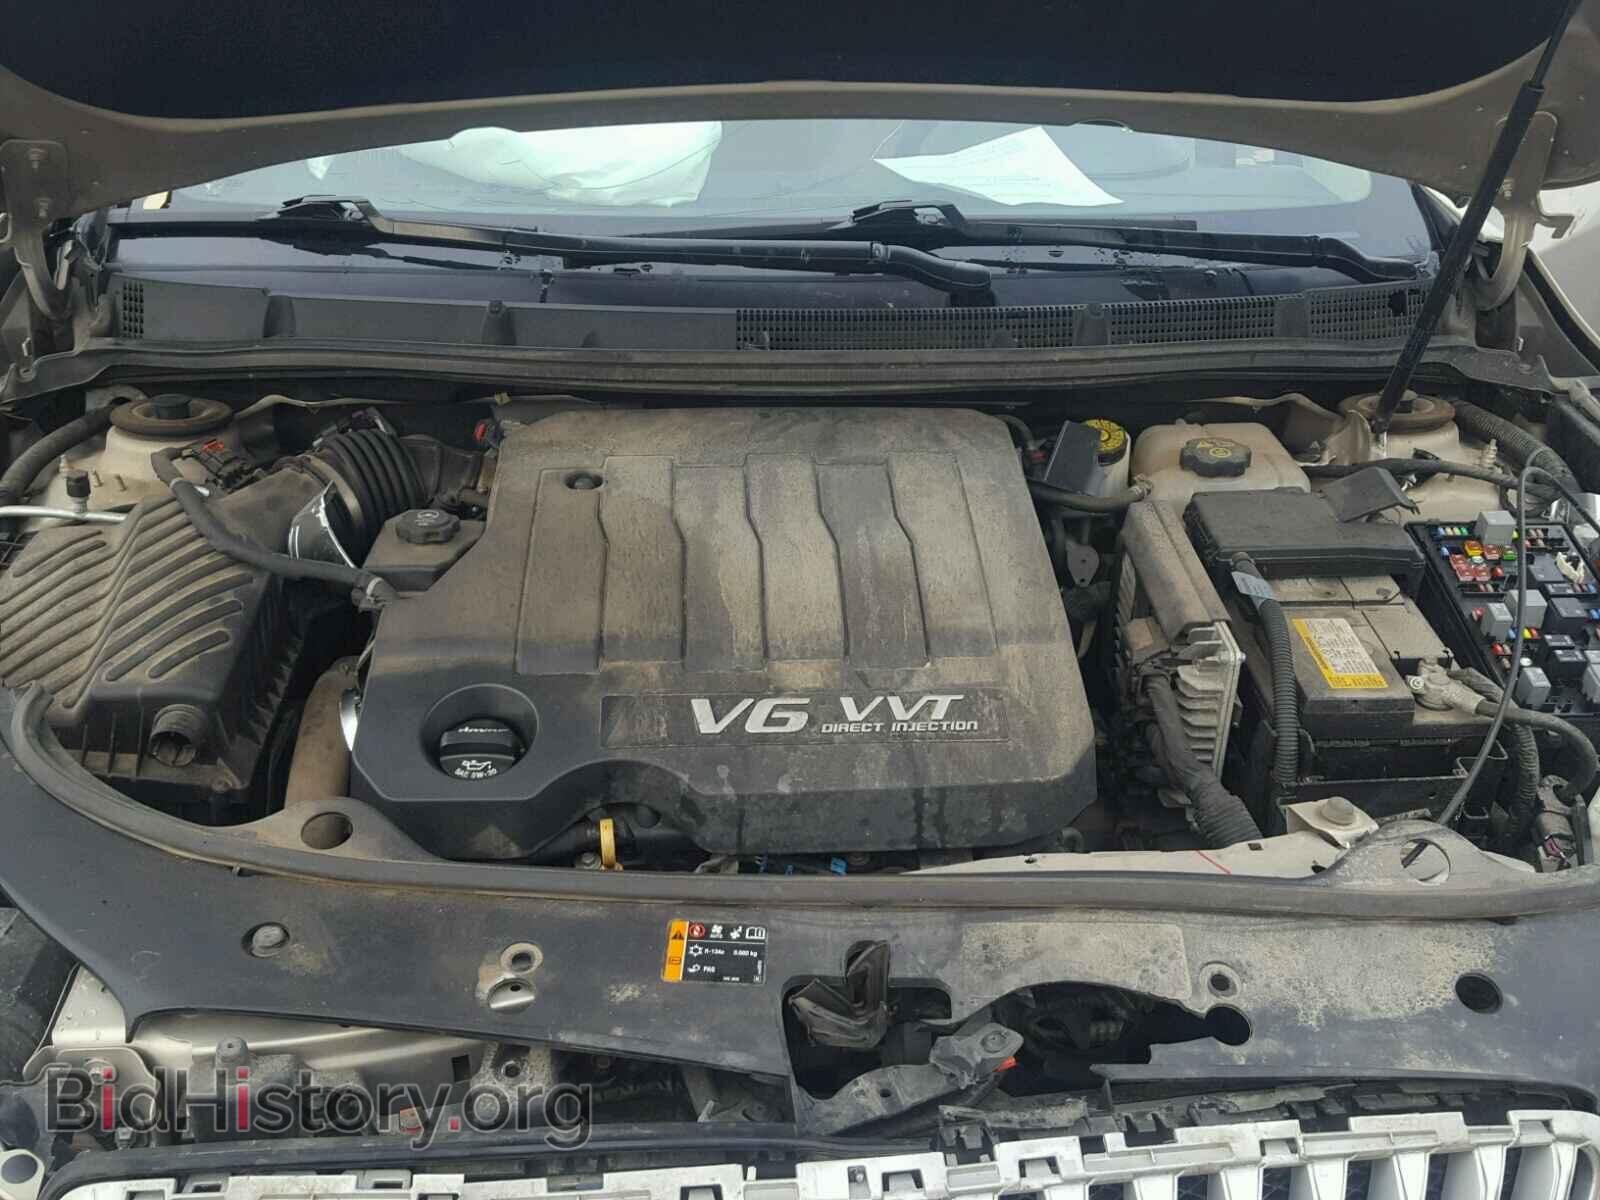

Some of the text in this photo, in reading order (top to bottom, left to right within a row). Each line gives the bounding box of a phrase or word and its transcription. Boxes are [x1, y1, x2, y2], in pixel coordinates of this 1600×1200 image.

[691, 698, 810, 734] V6
[839, 694, 964, 721] VVT
[821, 720, 979, 733] DIRECT INJECTION
